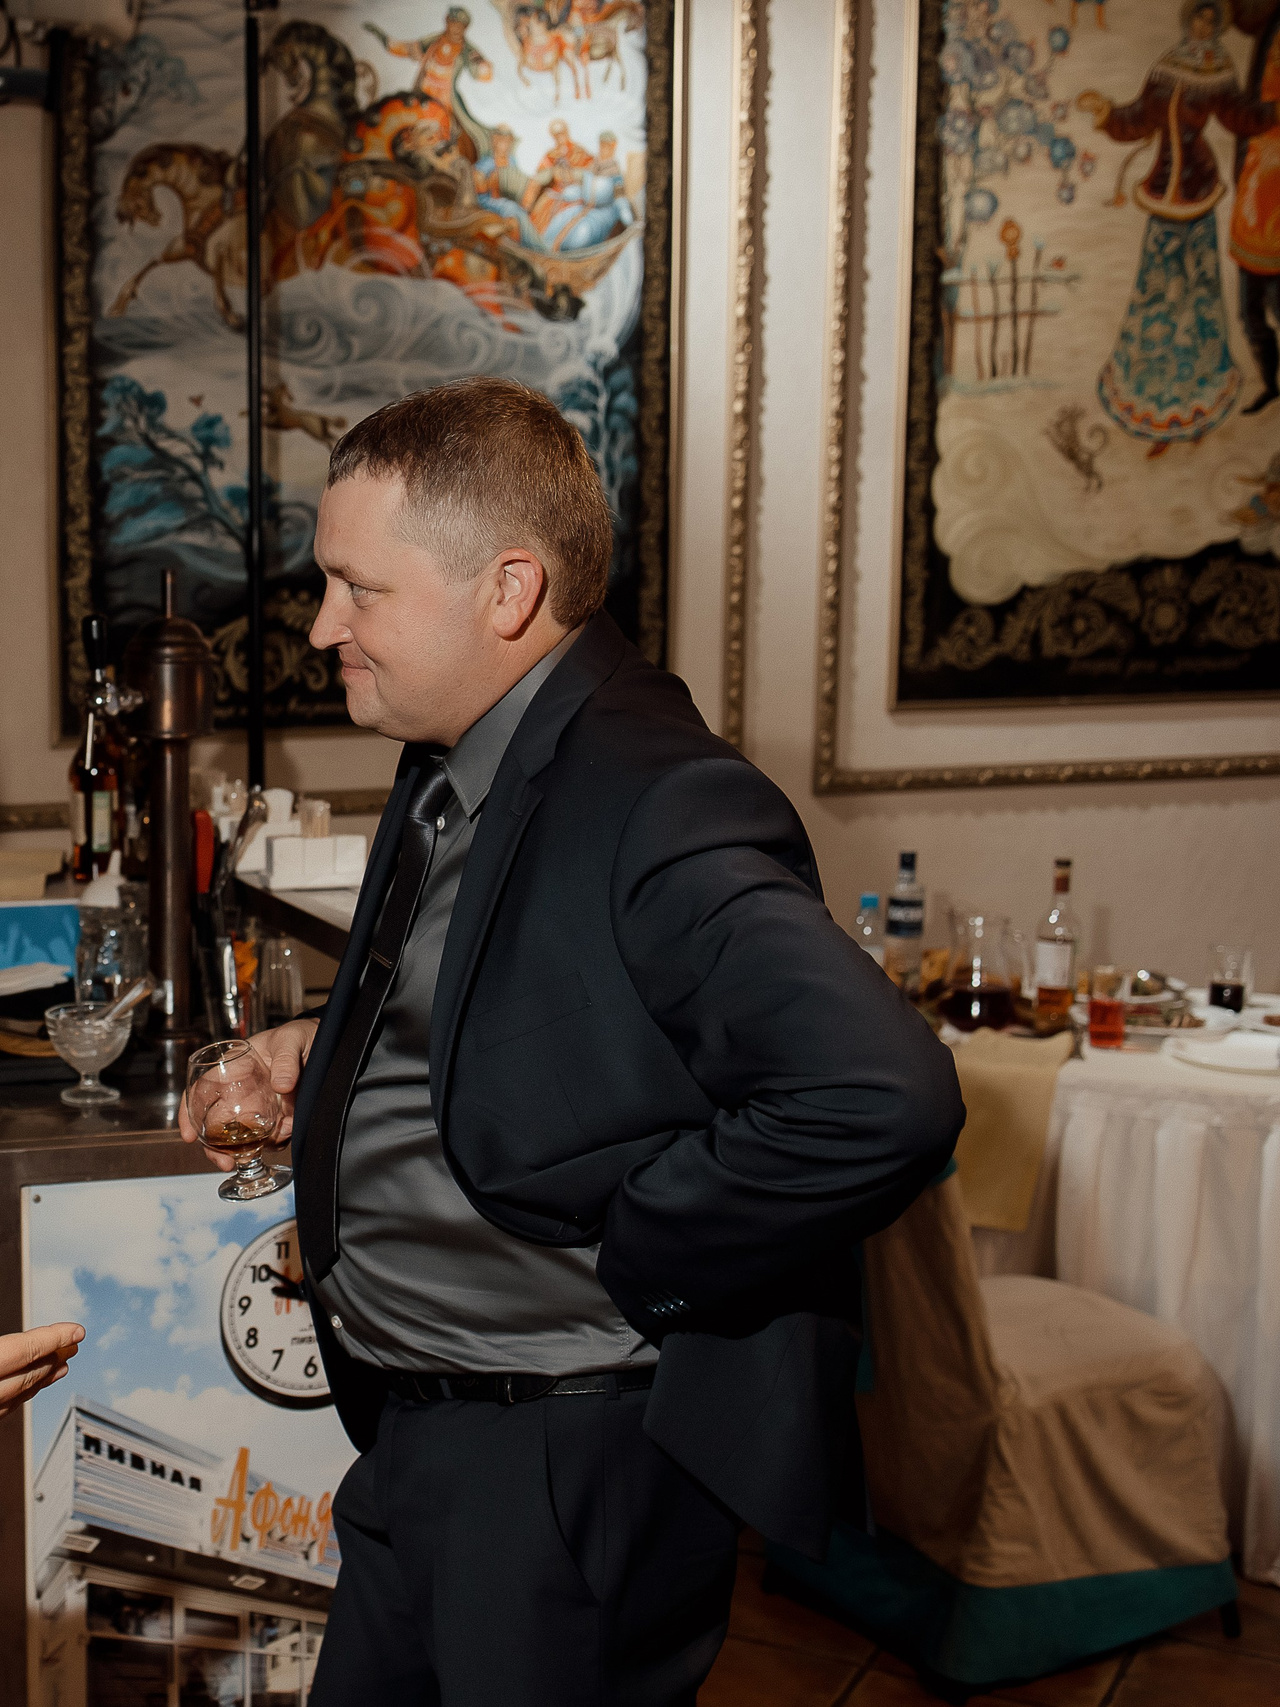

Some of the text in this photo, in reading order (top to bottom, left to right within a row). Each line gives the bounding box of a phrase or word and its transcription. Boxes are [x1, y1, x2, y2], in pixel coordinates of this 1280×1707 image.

[275, 1241, 290, 1260] 11
[250, 1264, 272, 1284] 10
[238, 1296, 252, 1316] 9
[245, 1327, 258, 1348] 8
[272, 1349, 285, 1372] 7
[304, 1355, 318, 1377] 6
[83, 1434, 202, 1492] ПИВНАЯ
